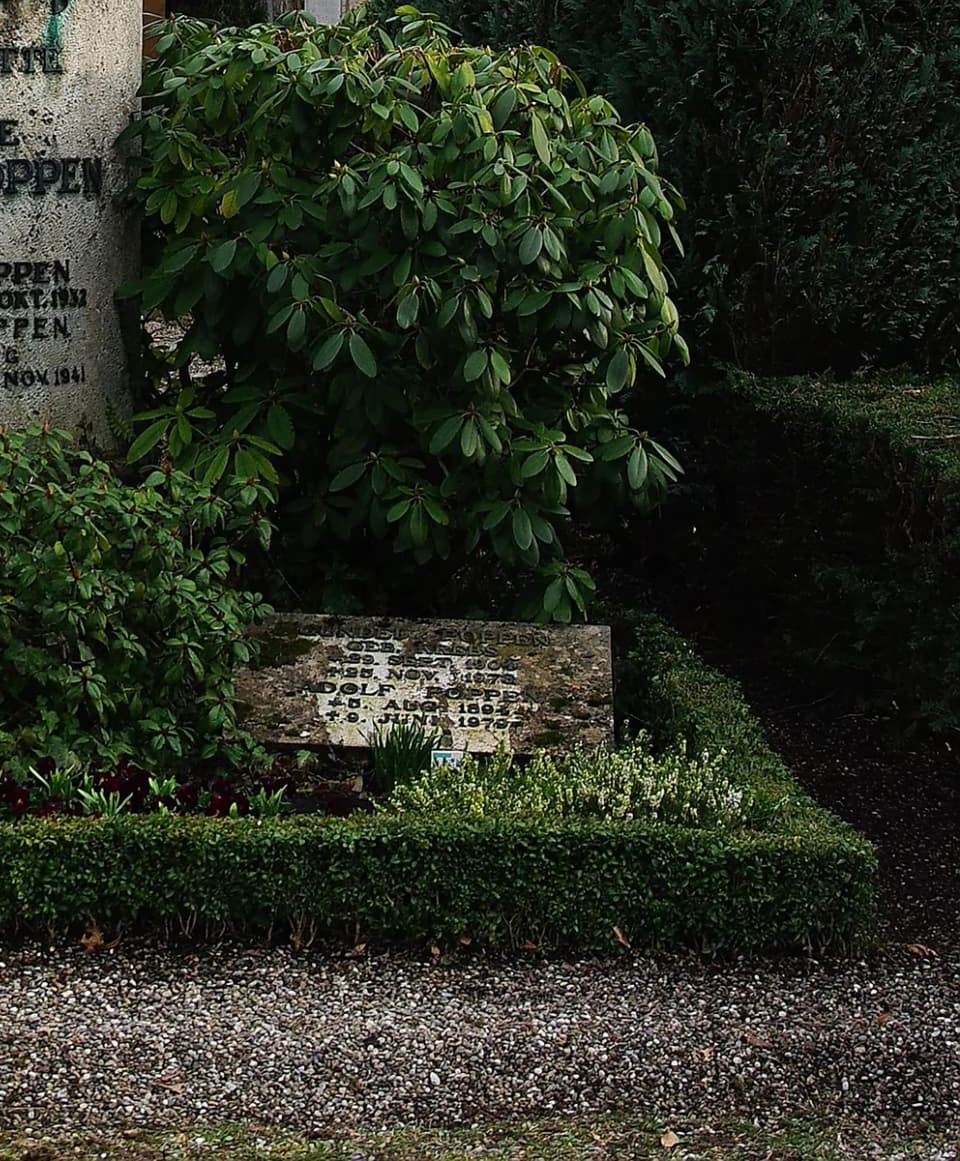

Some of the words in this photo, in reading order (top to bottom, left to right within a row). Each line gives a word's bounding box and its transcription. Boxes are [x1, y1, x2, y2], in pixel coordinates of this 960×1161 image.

[346, 641, 401, 653] GEB.
[387, 669, 440, 682] NOV.
[302, 681, 396, 696] ADOLF
[426, 686, 540, 703] POPPEN
